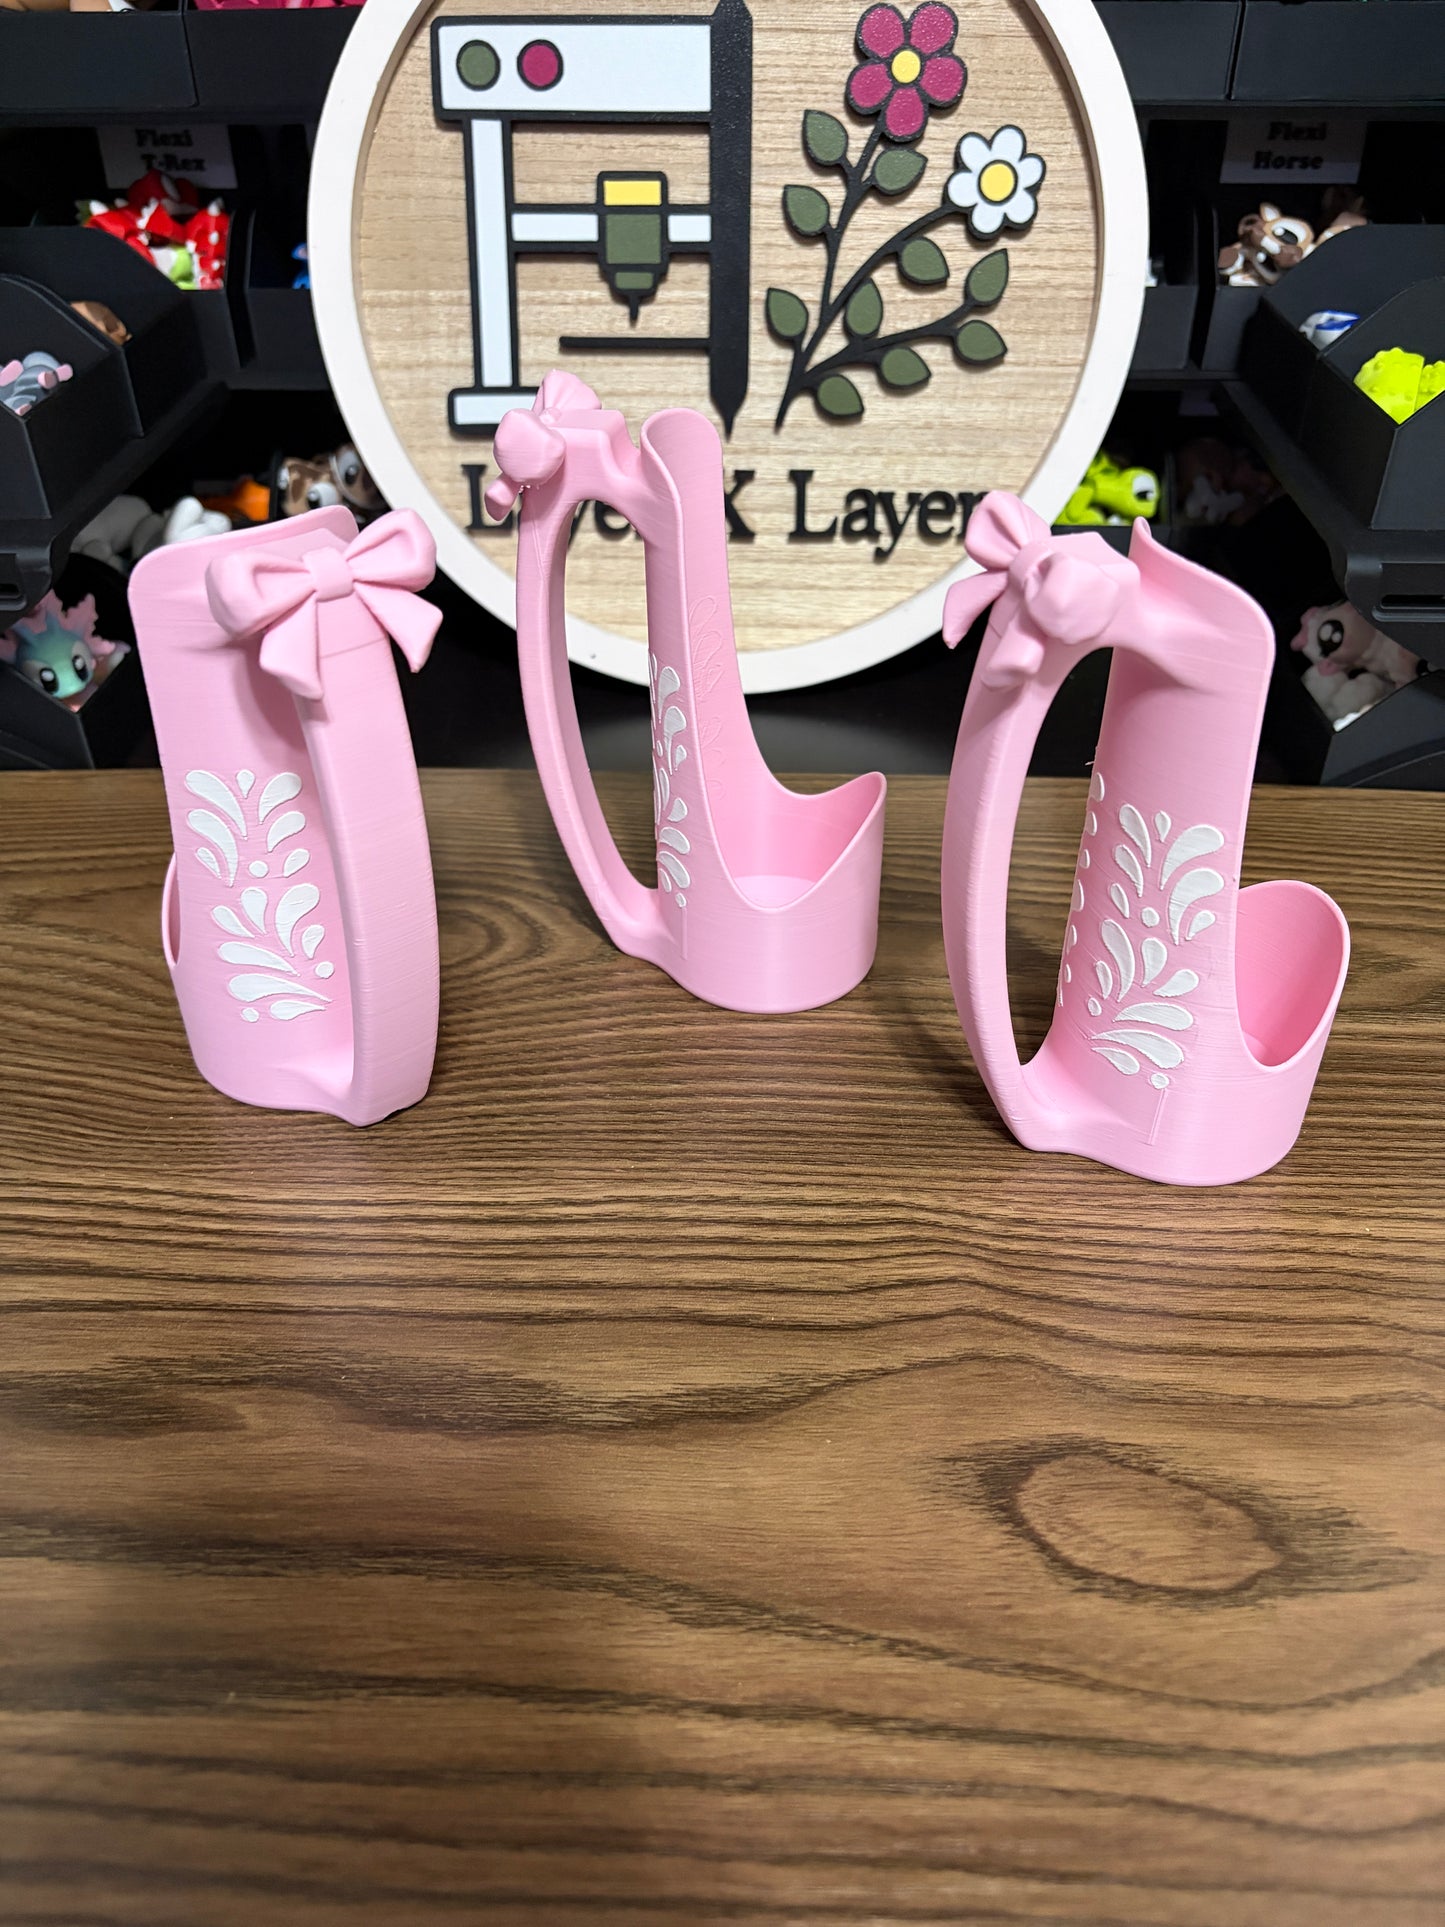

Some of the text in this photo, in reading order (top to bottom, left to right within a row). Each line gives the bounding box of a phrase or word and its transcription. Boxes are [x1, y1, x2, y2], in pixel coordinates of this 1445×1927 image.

[135, 128, 193, 147] Flexi
[1267, 121, 1328, 141] Flexi
[141, 153, 207, 171] T-Rex
[1253, 151, 1325, 170] Horse
